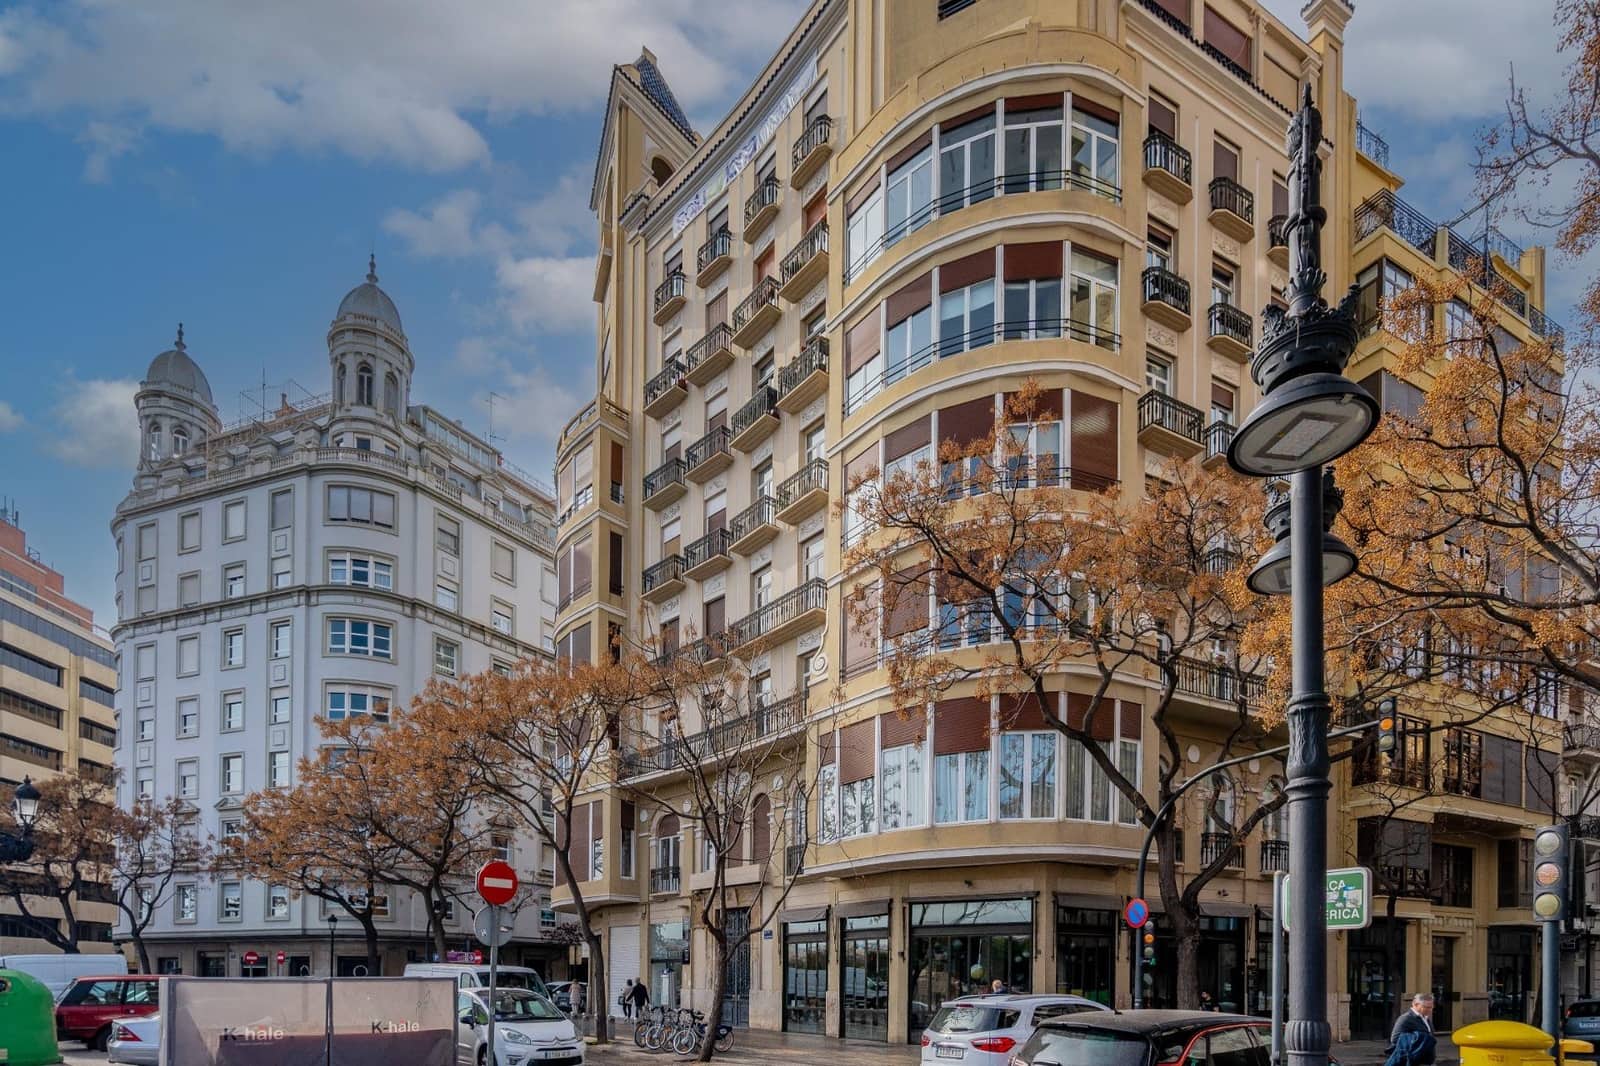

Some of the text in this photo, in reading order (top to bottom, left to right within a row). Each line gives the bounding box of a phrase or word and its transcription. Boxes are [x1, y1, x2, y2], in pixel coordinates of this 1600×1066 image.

[1326, 908, 1360, 920] RICA
[223, 1026, 284, 1041] K-hale
[371, 1020, 420, 1034] K-hale
